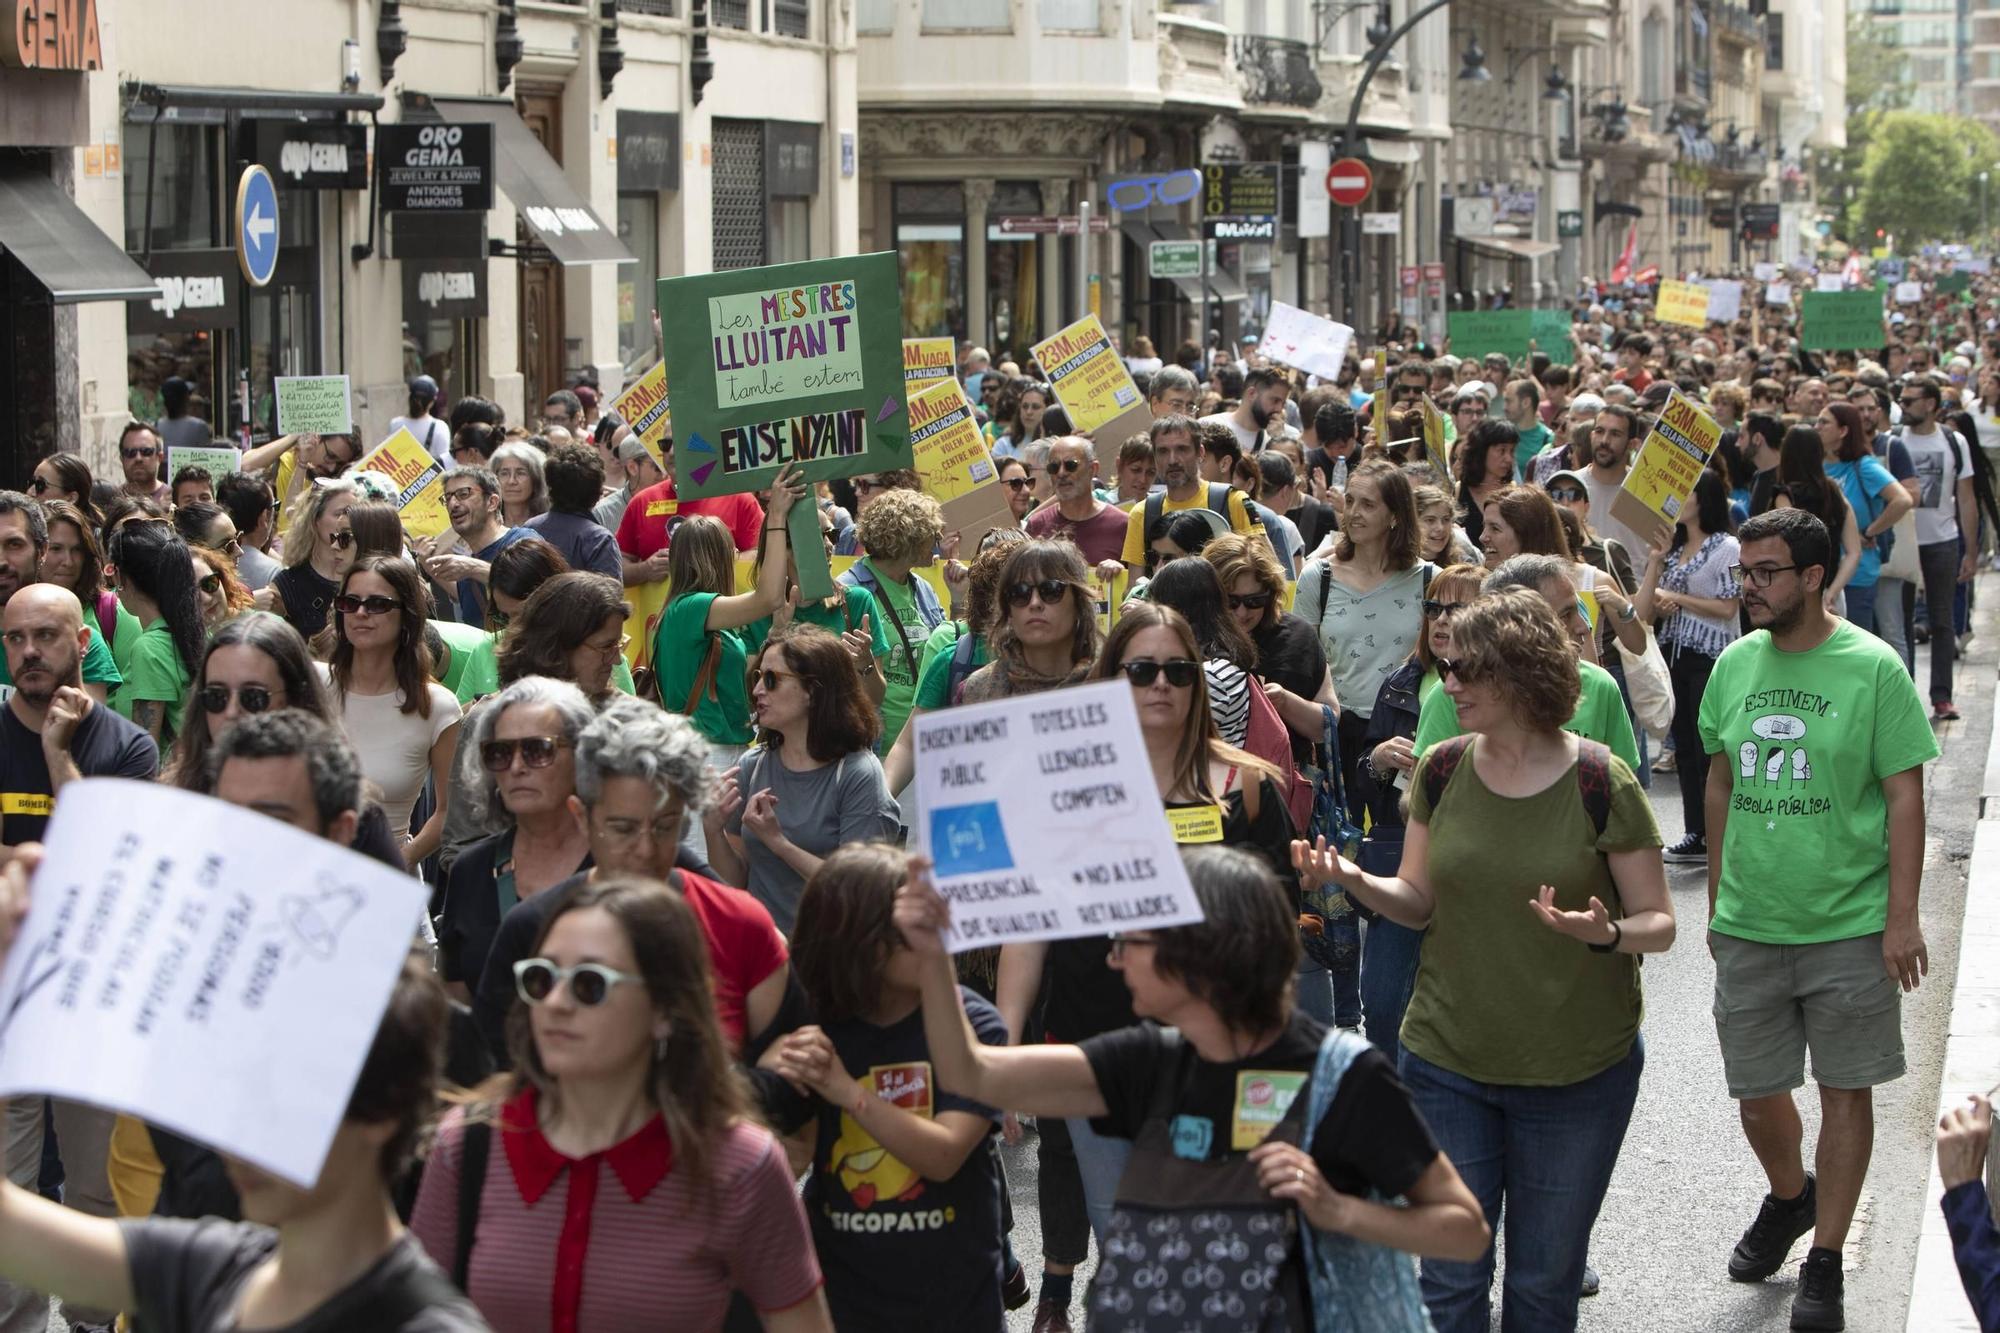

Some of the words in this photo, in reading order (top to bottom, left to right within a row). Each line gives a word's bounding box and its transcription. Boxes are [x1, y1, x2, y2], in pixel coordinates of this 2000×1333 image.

[16, 0, 103, 70] GEMA
[418, 126, 463, 149] ORO
[405, 148, 464, 167] GEMA
[389, 170, 438, 181] JEWELRY
[440, 170, 449, 181] &
[451, 170, 481, 181] PAWN
[406, 197, 464, 207] DIAMONDS
[407, 186, 463, 196] ANTIQUES
[716, 300, 753, 330] Les
[760, 284, 856, 325] MESTRES
[1036, 334, 1074, 371] 23M
[1072, 327, 1103, 352] VAGA
[1065, 364, 1075, 374] LA
[1073, 342, 1106, 370] PATACONA
[726, 369, 785, 401] també
[803, 364, 861, 388] estem
[1088, 381, 1113, 400] CENTRE
[617, 384, 655, 425] 23M
[929, 392, 963, 419] VAGA
[919, 429, 928, 440] LA
[927, 410, 965, 434] PATACONA
[1663, 396, 1699, 434] 23M
[1689, 423, 1716, 452] VAGA
[720, 409, 866, 474] ENSENYANT
[939, 433, 964, 455] VOLEM
[964, 432, 976, 443] UN
[941, 452, 968, 471] CENTRE
[968, 445, 984, 458] NOU
[392, 458, 425, 488] VAGA
[1030, 708, 1077, 733] TOTES
[1081, 703, 1109, 726] LES
[1744, 689, 1832, 718] ESTIMEM
[1052, 783, 1128, 813] COMPTEN
[1130, 857, 1158, 880] LES
[1077, 895, 1180, 924] RETALLADES
[961, 916, 986, 938] DE
